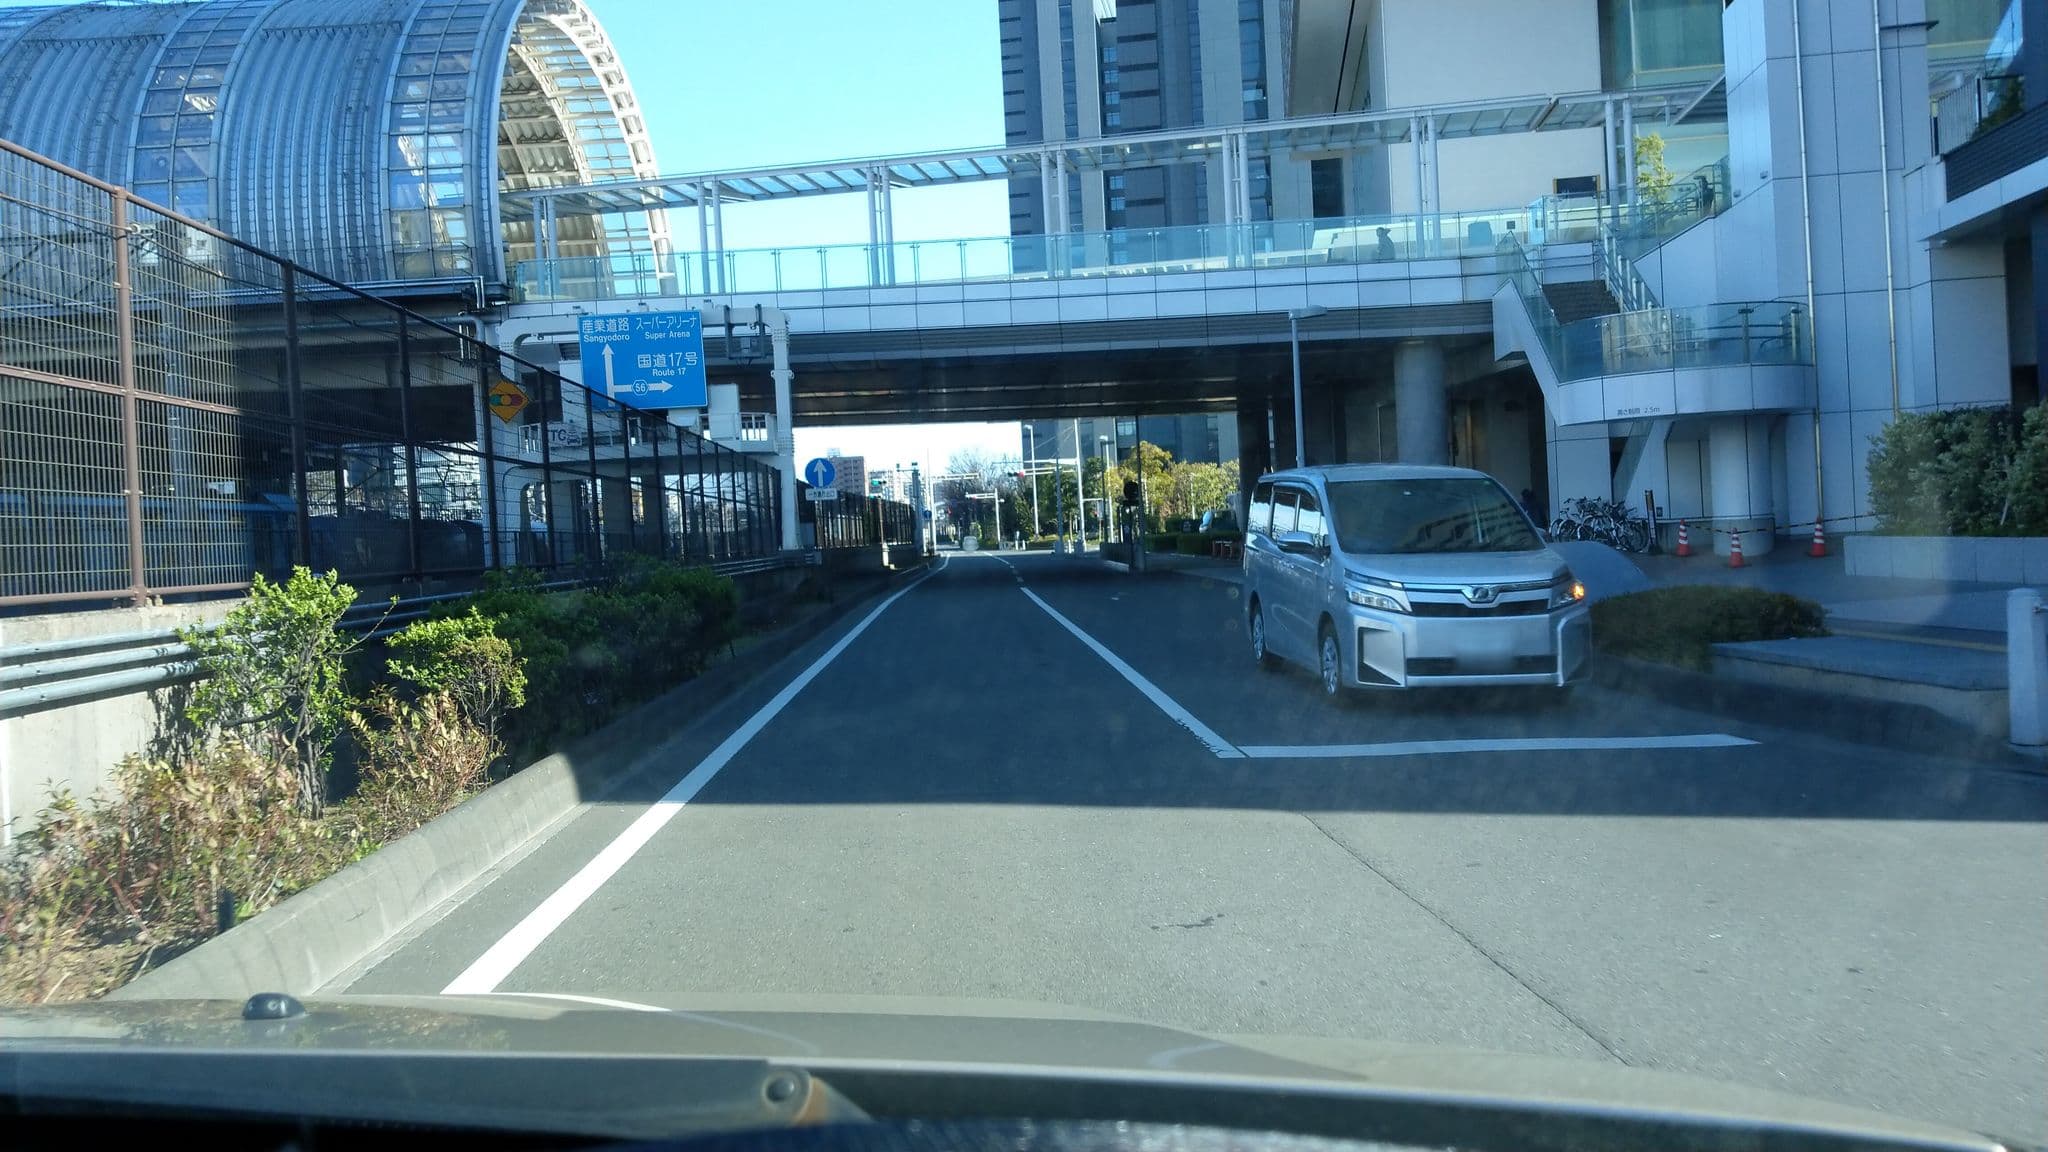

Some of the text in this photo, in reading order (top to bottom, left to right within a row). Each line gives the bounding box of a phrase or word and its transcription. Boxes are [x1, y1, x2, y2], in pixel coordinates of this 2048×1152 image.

[582, 317, 629, 333] 産業道路
[636, 315, 697, 330] スーパーアリーナ
[583, 333, 630, 343] Sangyodoro
[645, 330, 690, 340] Super Arena
[638, 351, 698, 368] 国道17号
[652, 367, 686, 376] Route 17
[635, 383, 645, 392] 56
